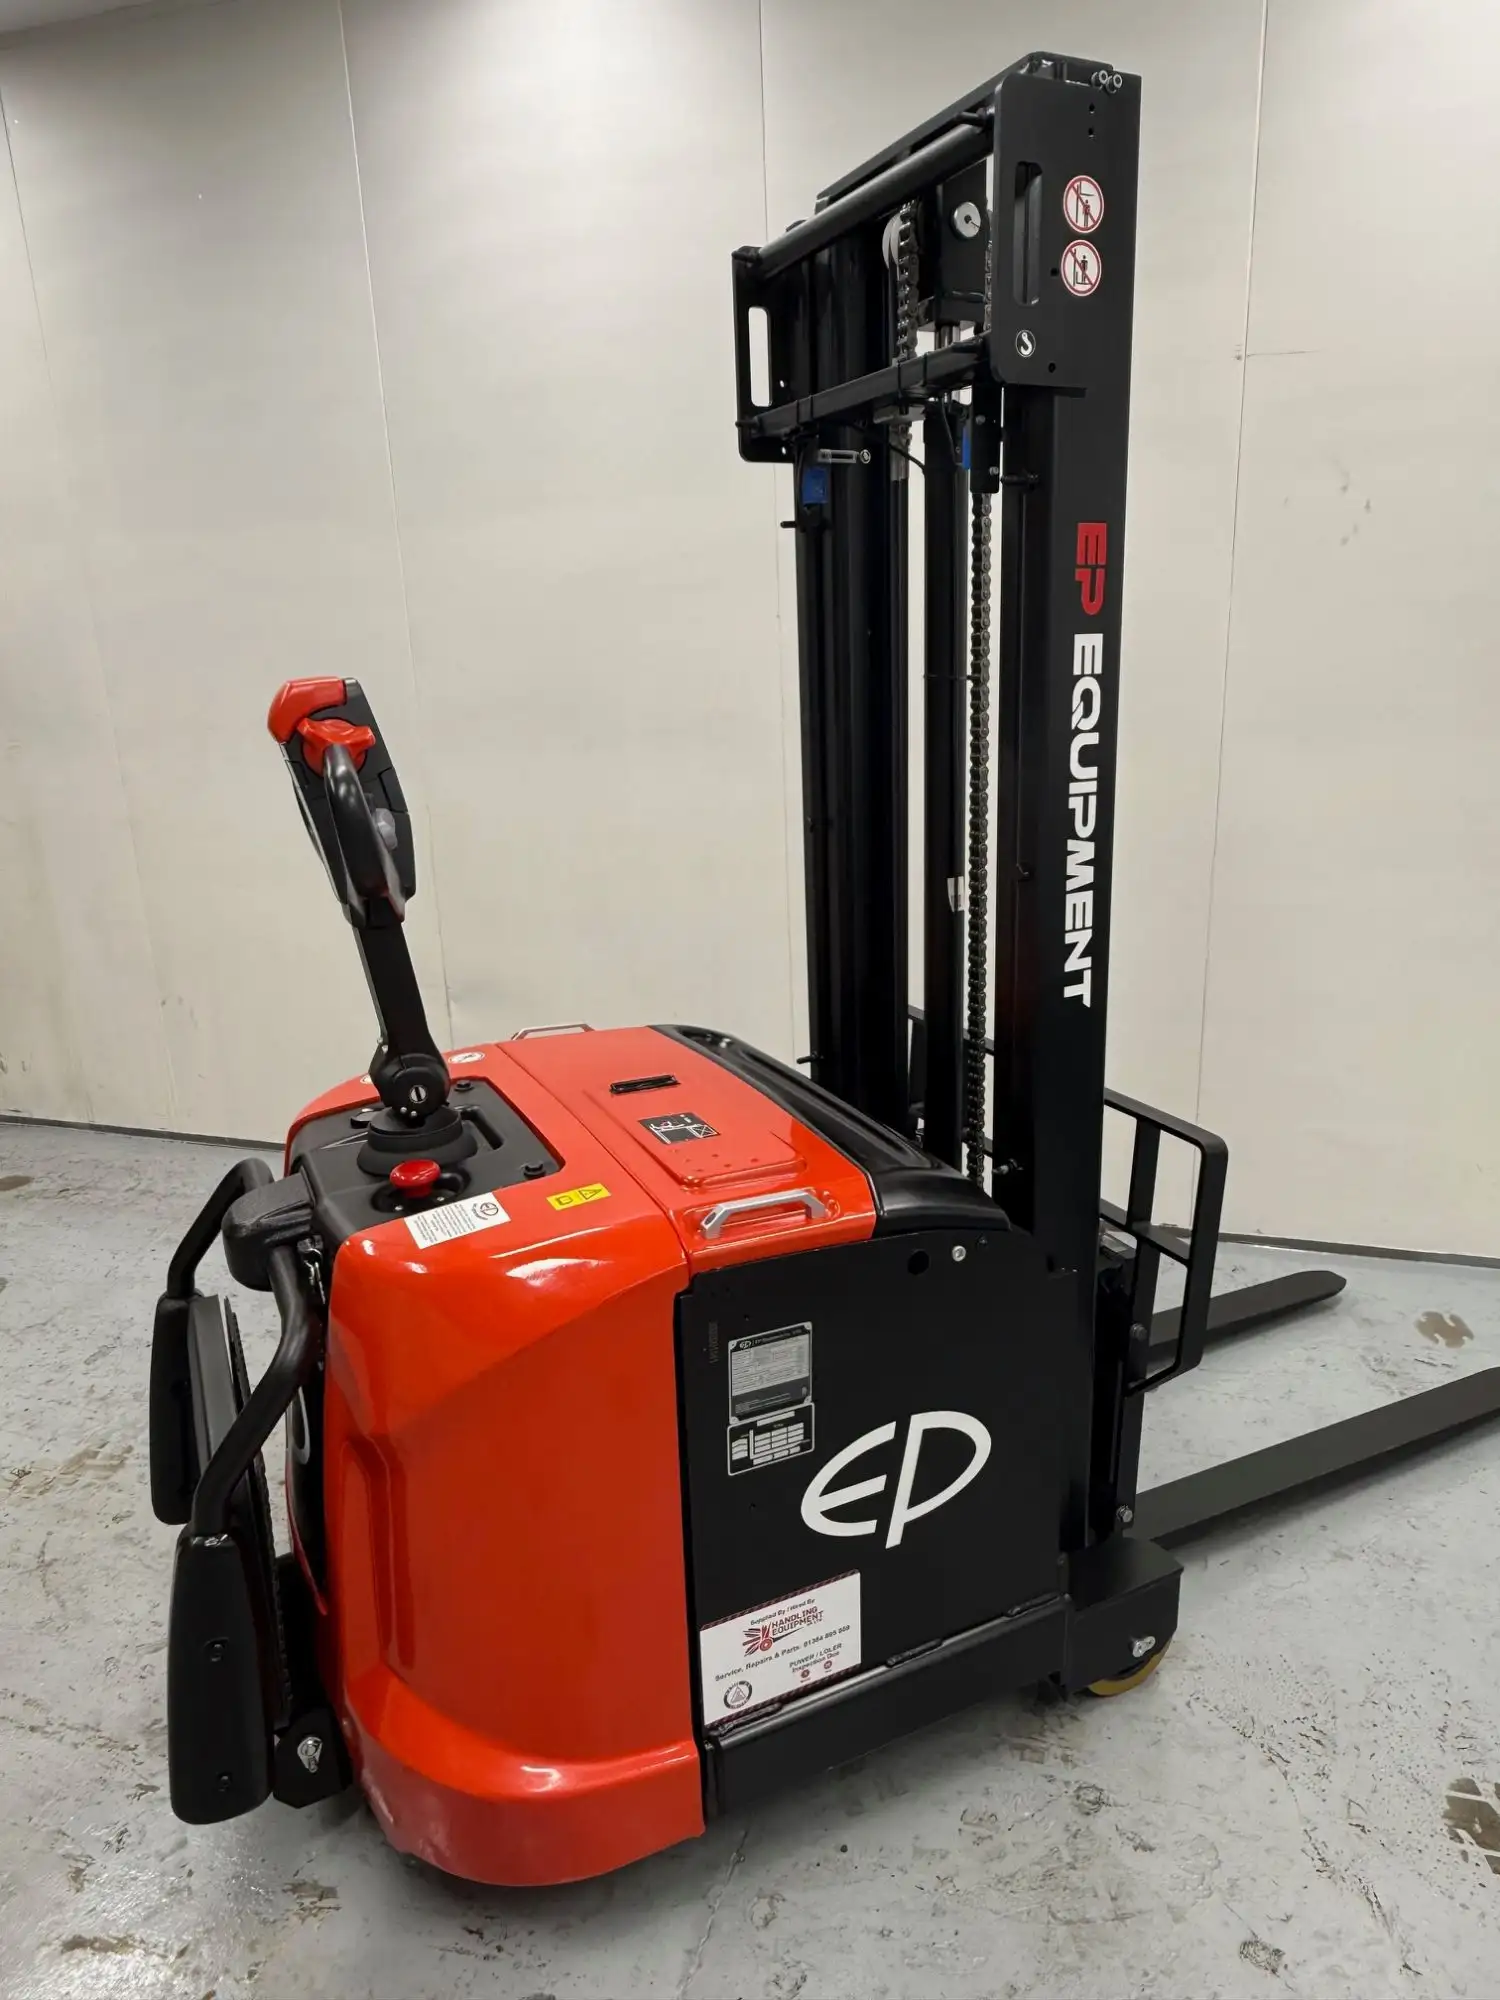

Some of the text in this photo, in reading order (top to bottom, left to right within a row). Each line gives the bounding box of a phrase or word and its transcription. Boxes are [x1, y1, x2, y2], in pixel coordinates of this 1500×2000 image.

[1064, 523, 1107, 1008] EP EQUIPMENT
[801, 1411, 991, 1549] EP
[772, 1606, 818, 1628] HANDLING
[772, 1610, 824, 1635] EQUIPMENT
[820, 1643, 842, 1657] LOLER
[714, 1667, 744, 1681] Service,
[745, 1655, 772, 1670] Repairs
